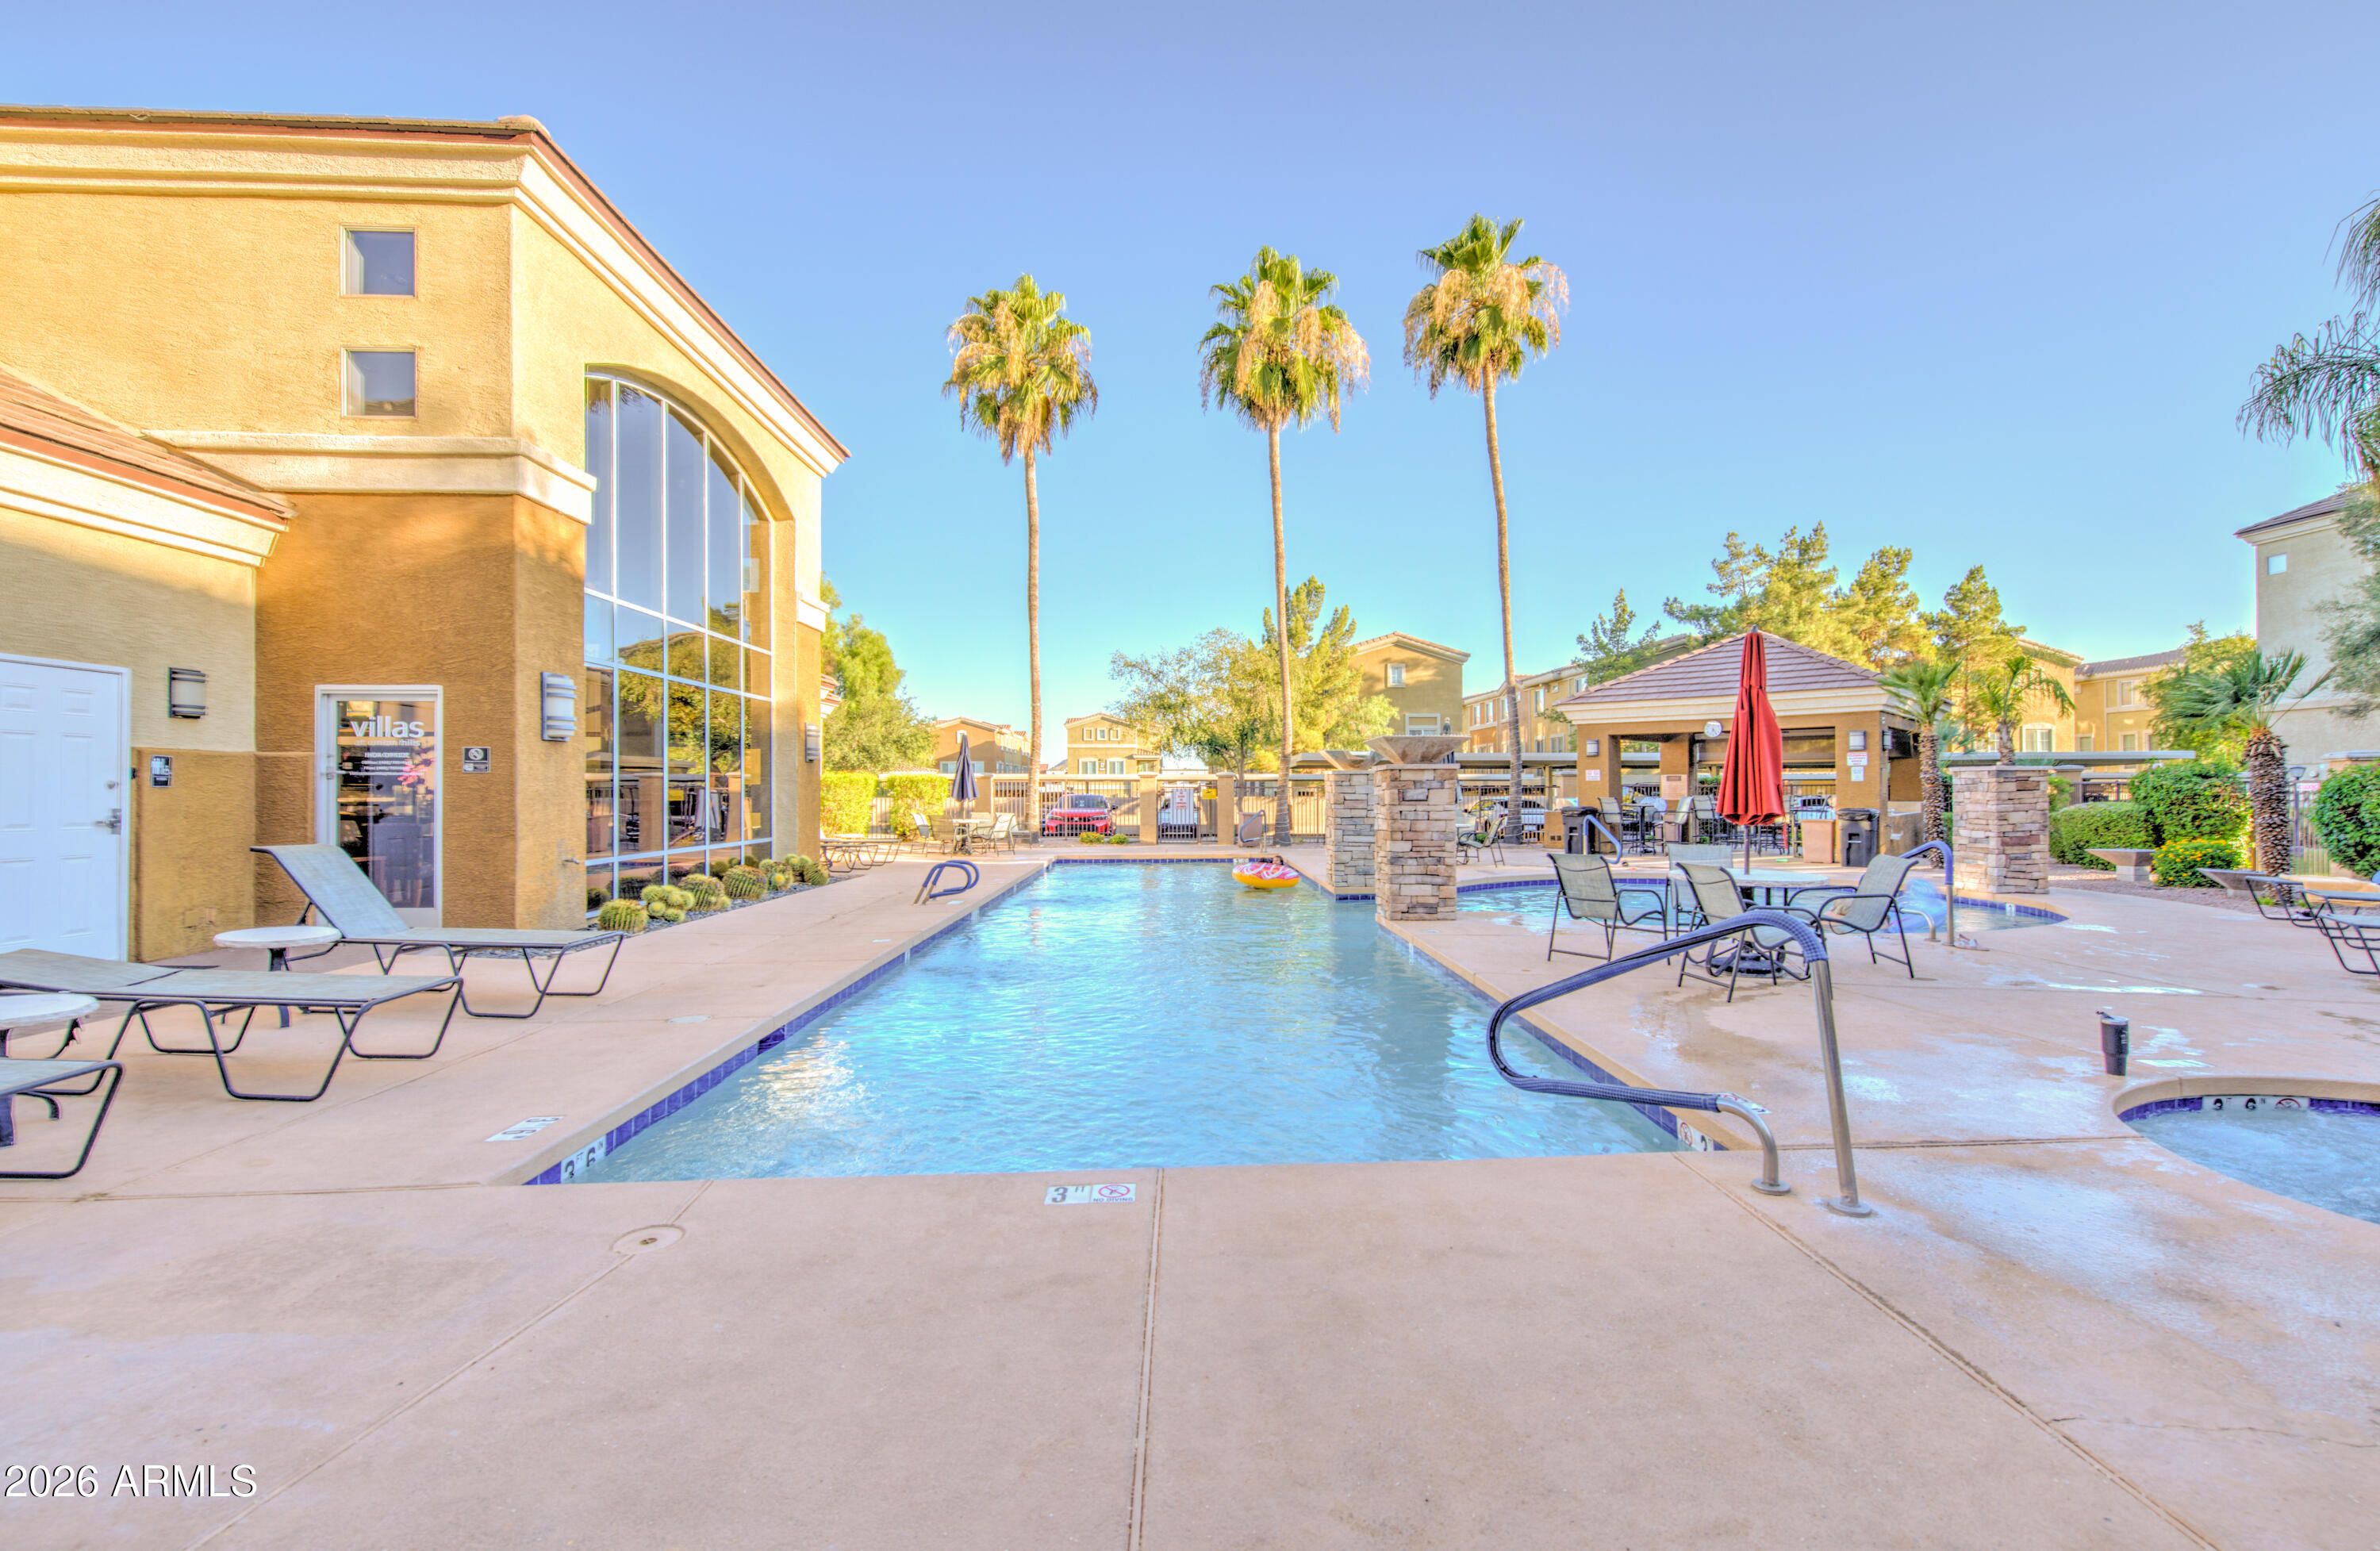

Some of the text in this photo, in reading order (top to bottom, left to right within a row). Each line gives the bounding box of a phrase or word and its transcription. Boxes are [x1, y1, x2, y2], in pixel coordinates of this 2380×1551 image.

[351, 716, 424, 738] villas
[565, 1160, 575, 1179] 3
[576, 1152, 585, 1163] FT
